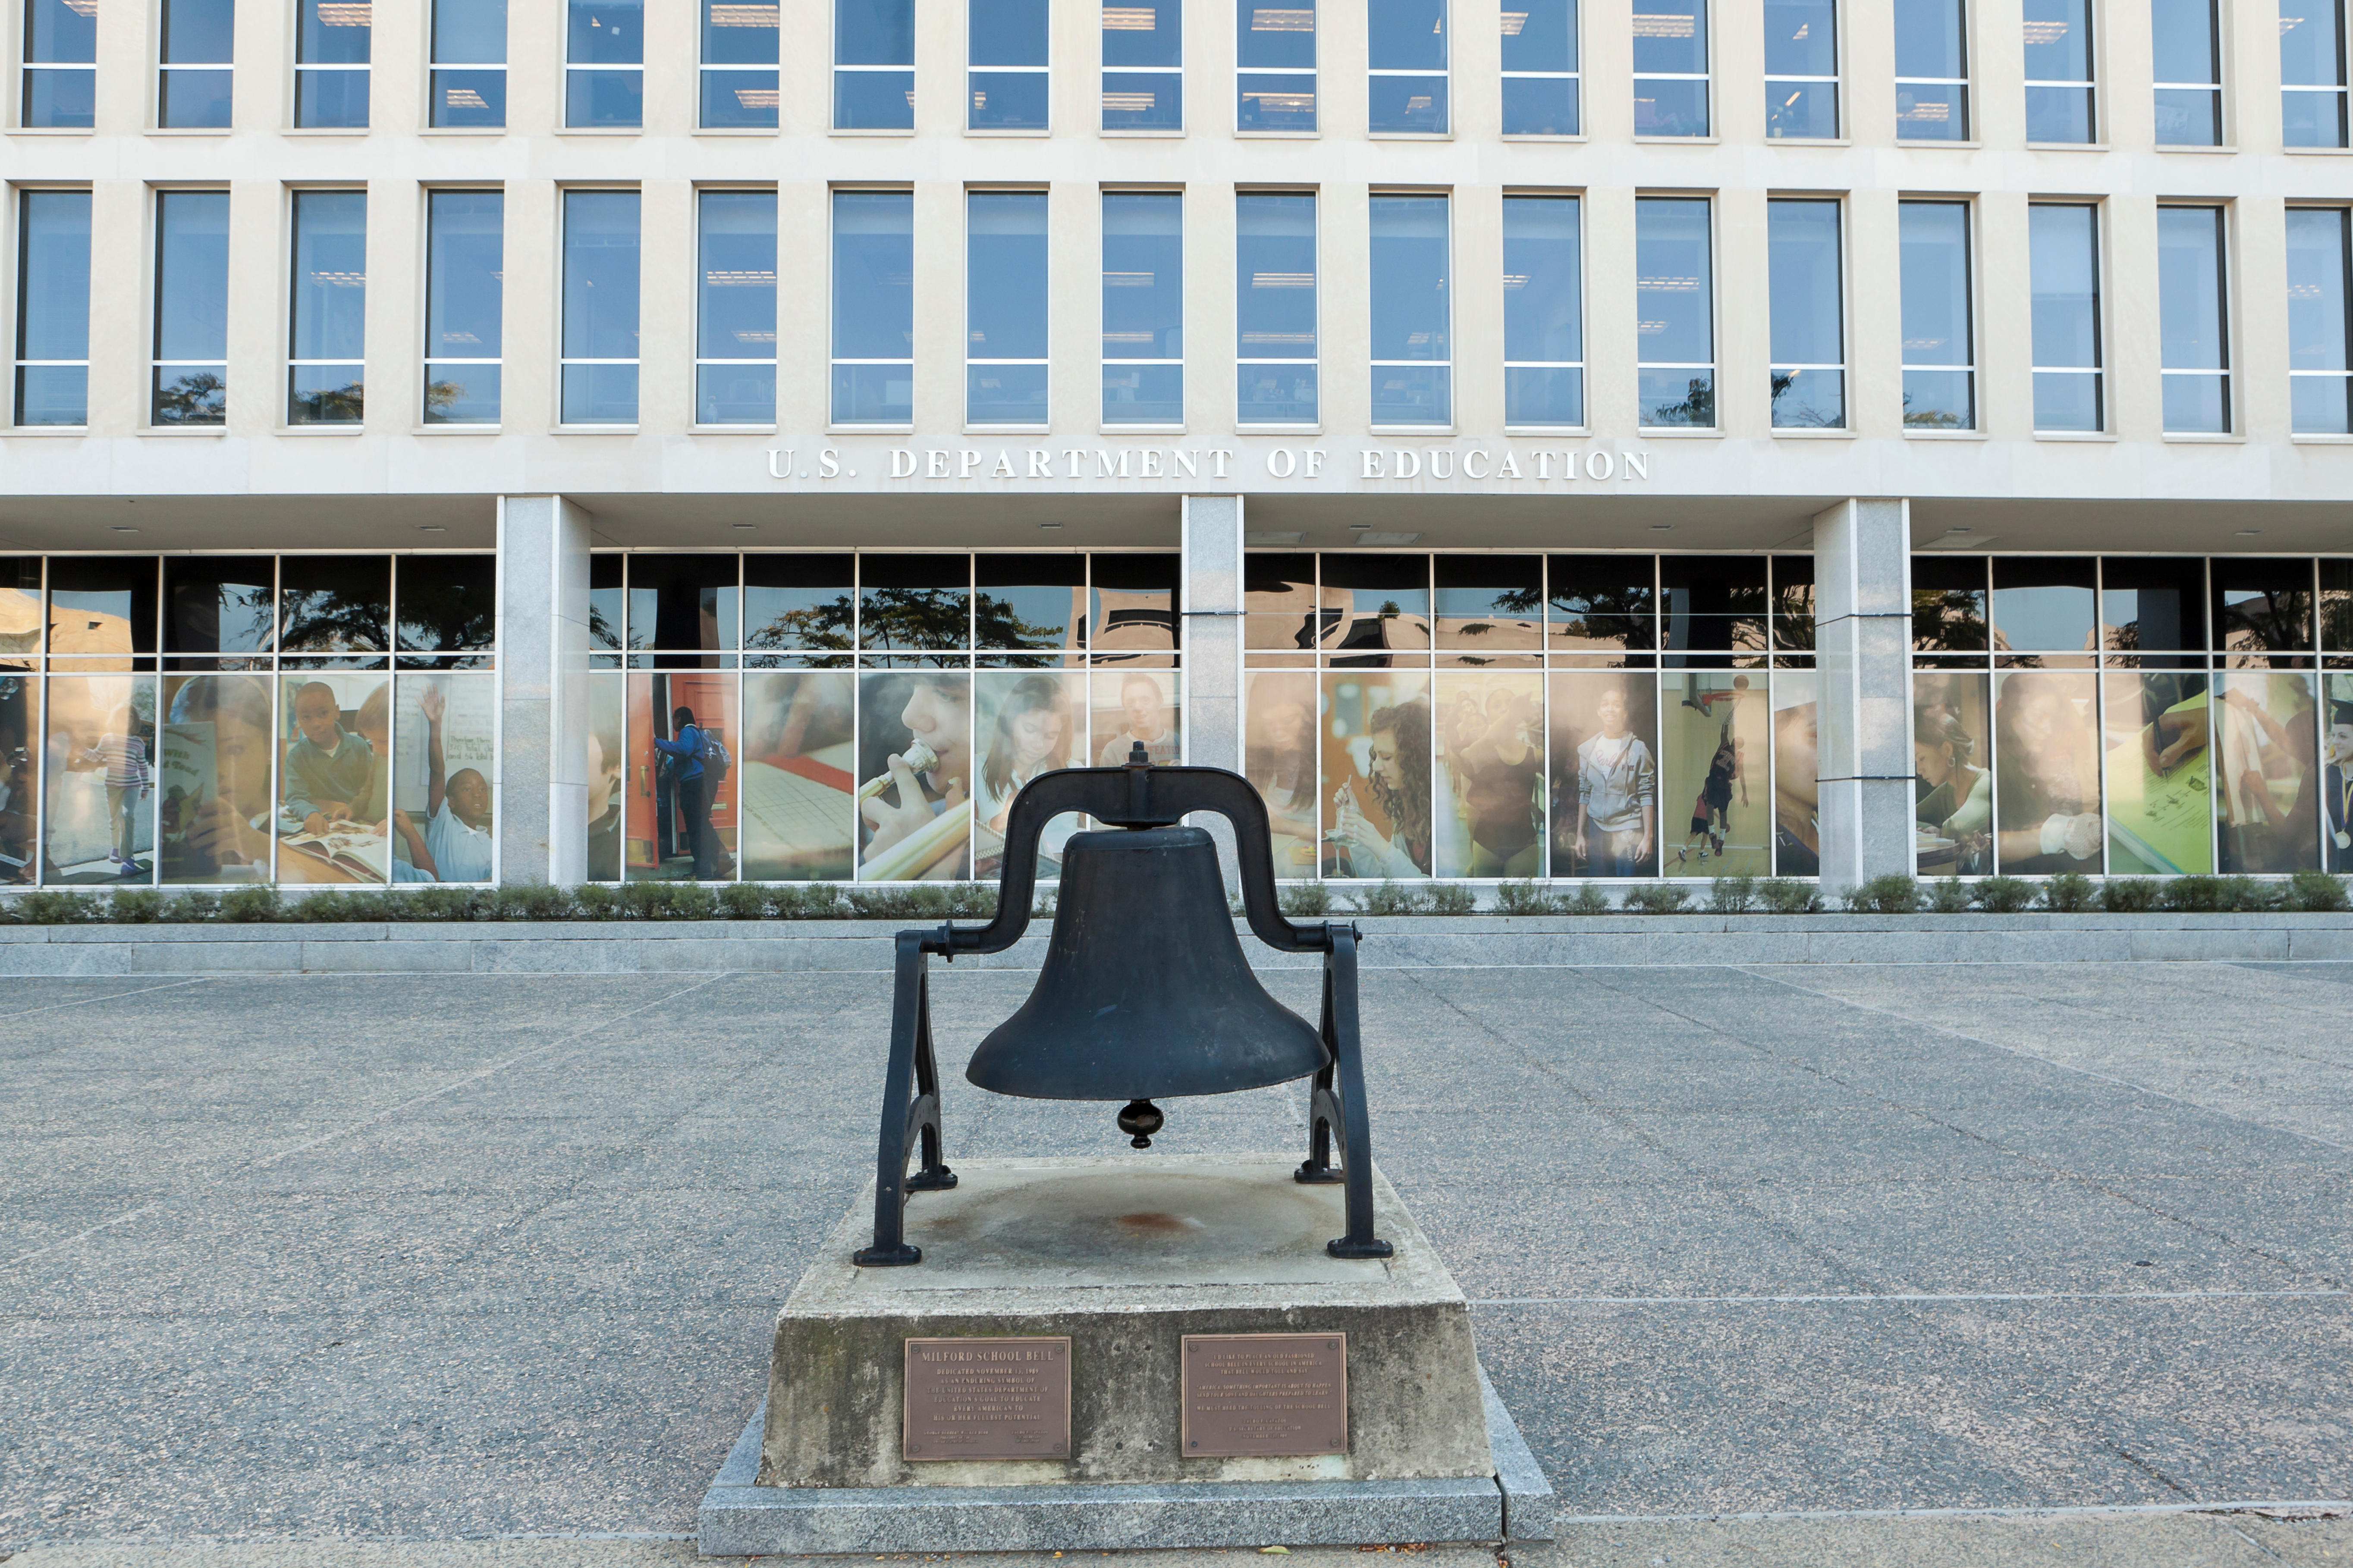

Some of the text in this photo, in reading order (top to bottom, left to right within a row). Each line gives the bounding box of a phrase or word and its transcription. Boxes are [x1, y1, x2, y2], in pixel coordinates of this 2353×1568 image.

[766, 449, 1649, 480] U.S. DEPARTMENT OF EDUCATION
[922, 1351, 1053, 1362] MILFORD SCHOOL BELL
